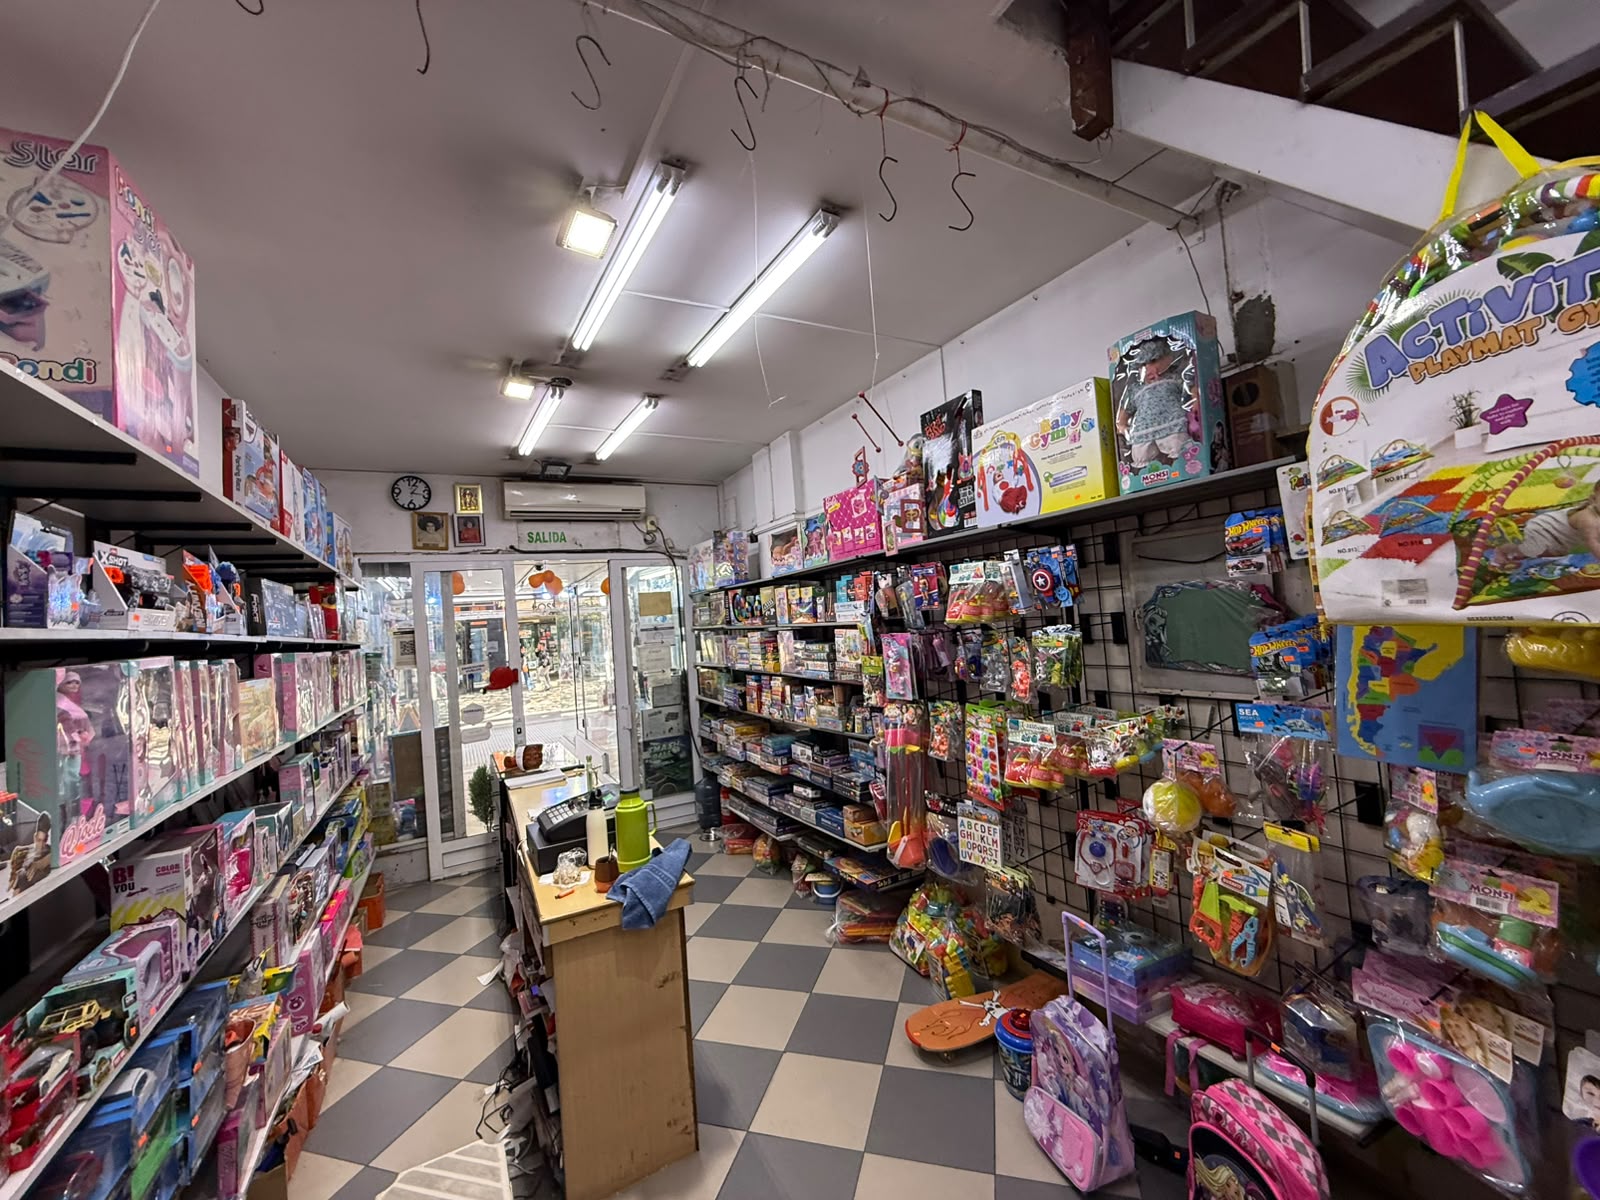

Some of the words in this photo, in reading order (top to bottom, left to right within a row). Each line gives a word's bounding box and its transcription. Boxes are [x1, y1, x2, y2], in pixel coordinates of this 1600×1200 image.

[4, 139, 98, 174] Star
[1407, 316, 1543, 384] PLAYMAT
[0, 352, 96, 384] ondi
[1039, 410, 1082, 433] Baby
[1029, 427, 1067, 448] Gym
[407, 478, 419, 487] 12
[1141, 470, 1169, 482] MONSI
[393, 487, 402, 497] 9
[422, 489, 431, 500] 3
[407, 499, 416, 510] 6
[1227, 523, 1243, 536] HOT
[1241, 518, 1271, 534] WHEELS
[527, 531, 567, 543] SALIDA
[251, 593, 260, 624] FORCE
[1253, 643, 1269, 656] HOT
[1269, 639, 1299, 652] WHEELS
[1238, 708, 1259, 716] SEA
[1535, 751, 1586, 762] MONSI
[112, 865, 135, 884] B!
[155, 863, 180, 873] COLOR
[113, 882, 136, 894] YOU
[1469, 884, 1514, 900] MONSI
